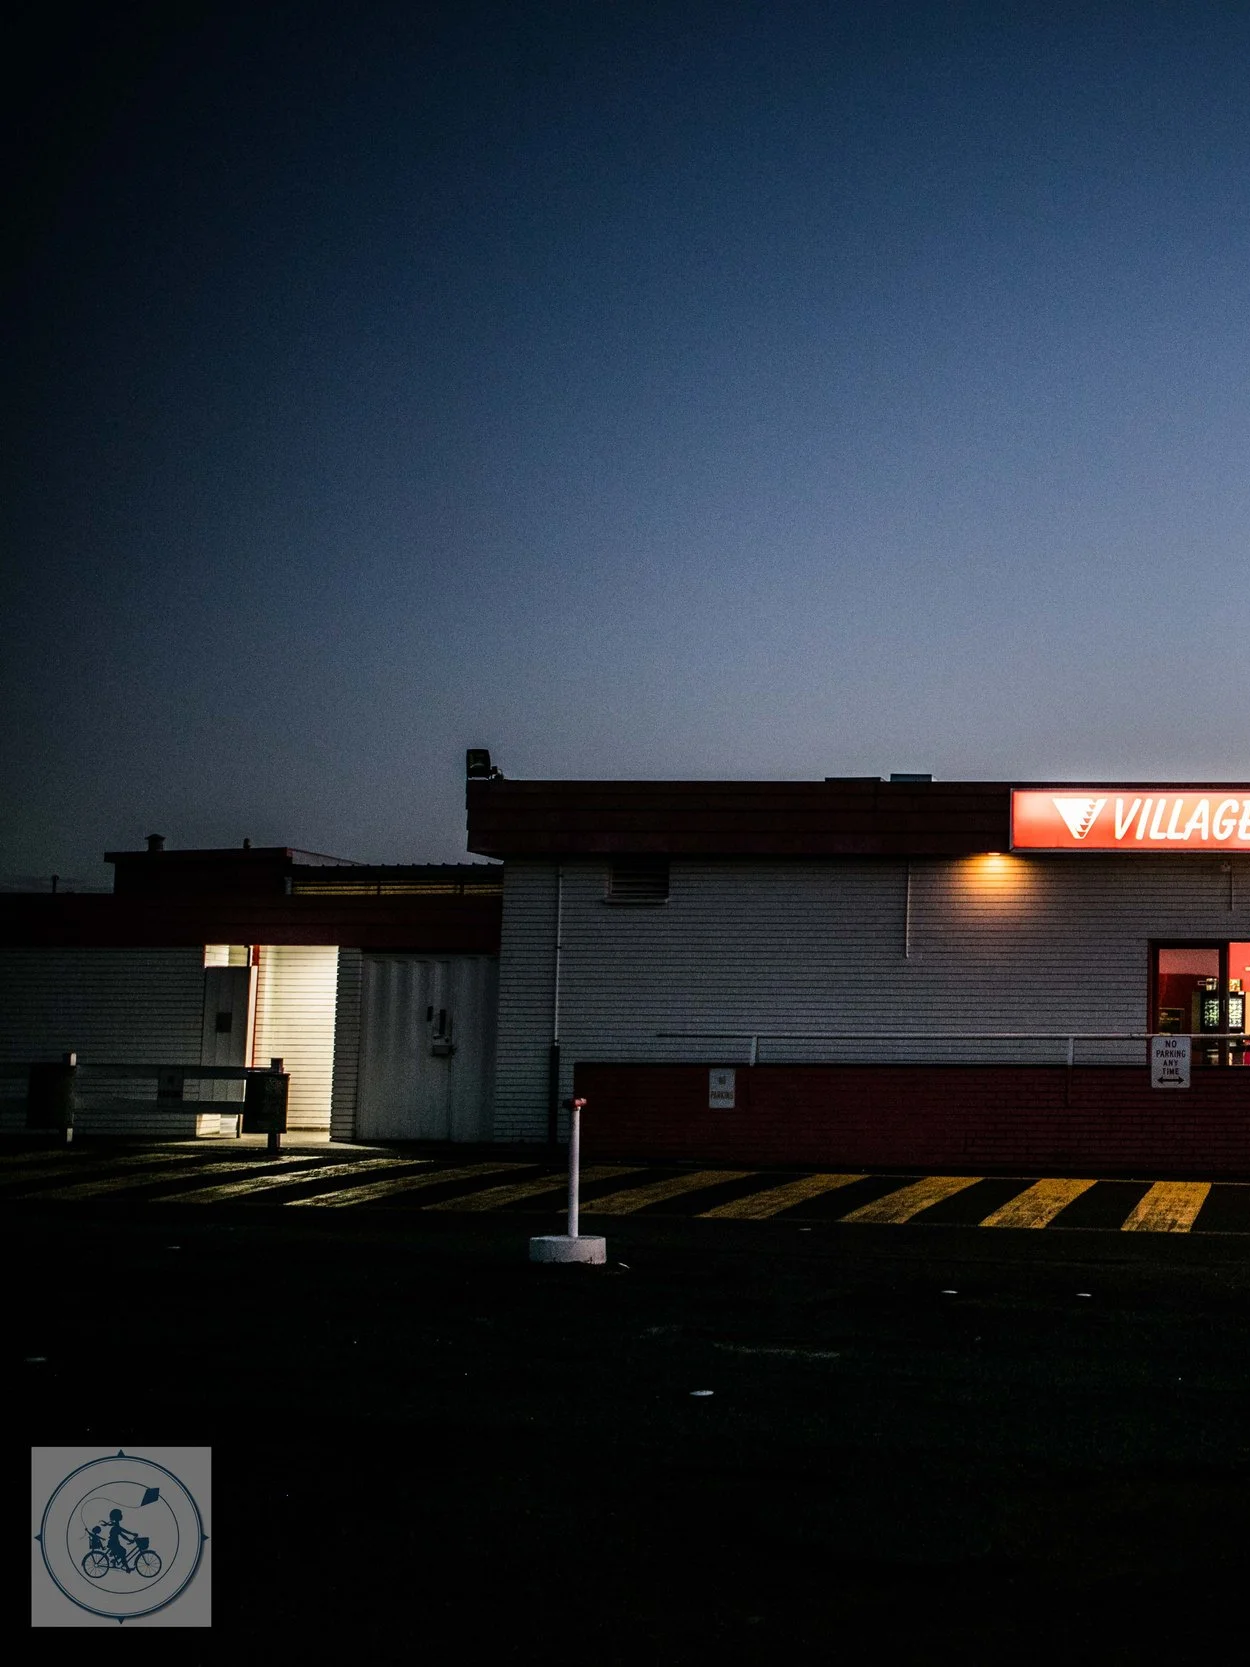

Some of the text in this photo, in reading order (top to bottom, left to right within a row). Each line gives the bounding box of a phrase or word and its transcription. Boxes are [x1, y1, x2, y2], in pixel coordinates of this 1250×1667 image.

[1165, 1039, 1178, 1048] NO
[1155, 1049, 1186, 1058] PARKING
[1162, 1059, 1179, 1067] ANY
[1162, 1067, 1180, 1075] TIME
